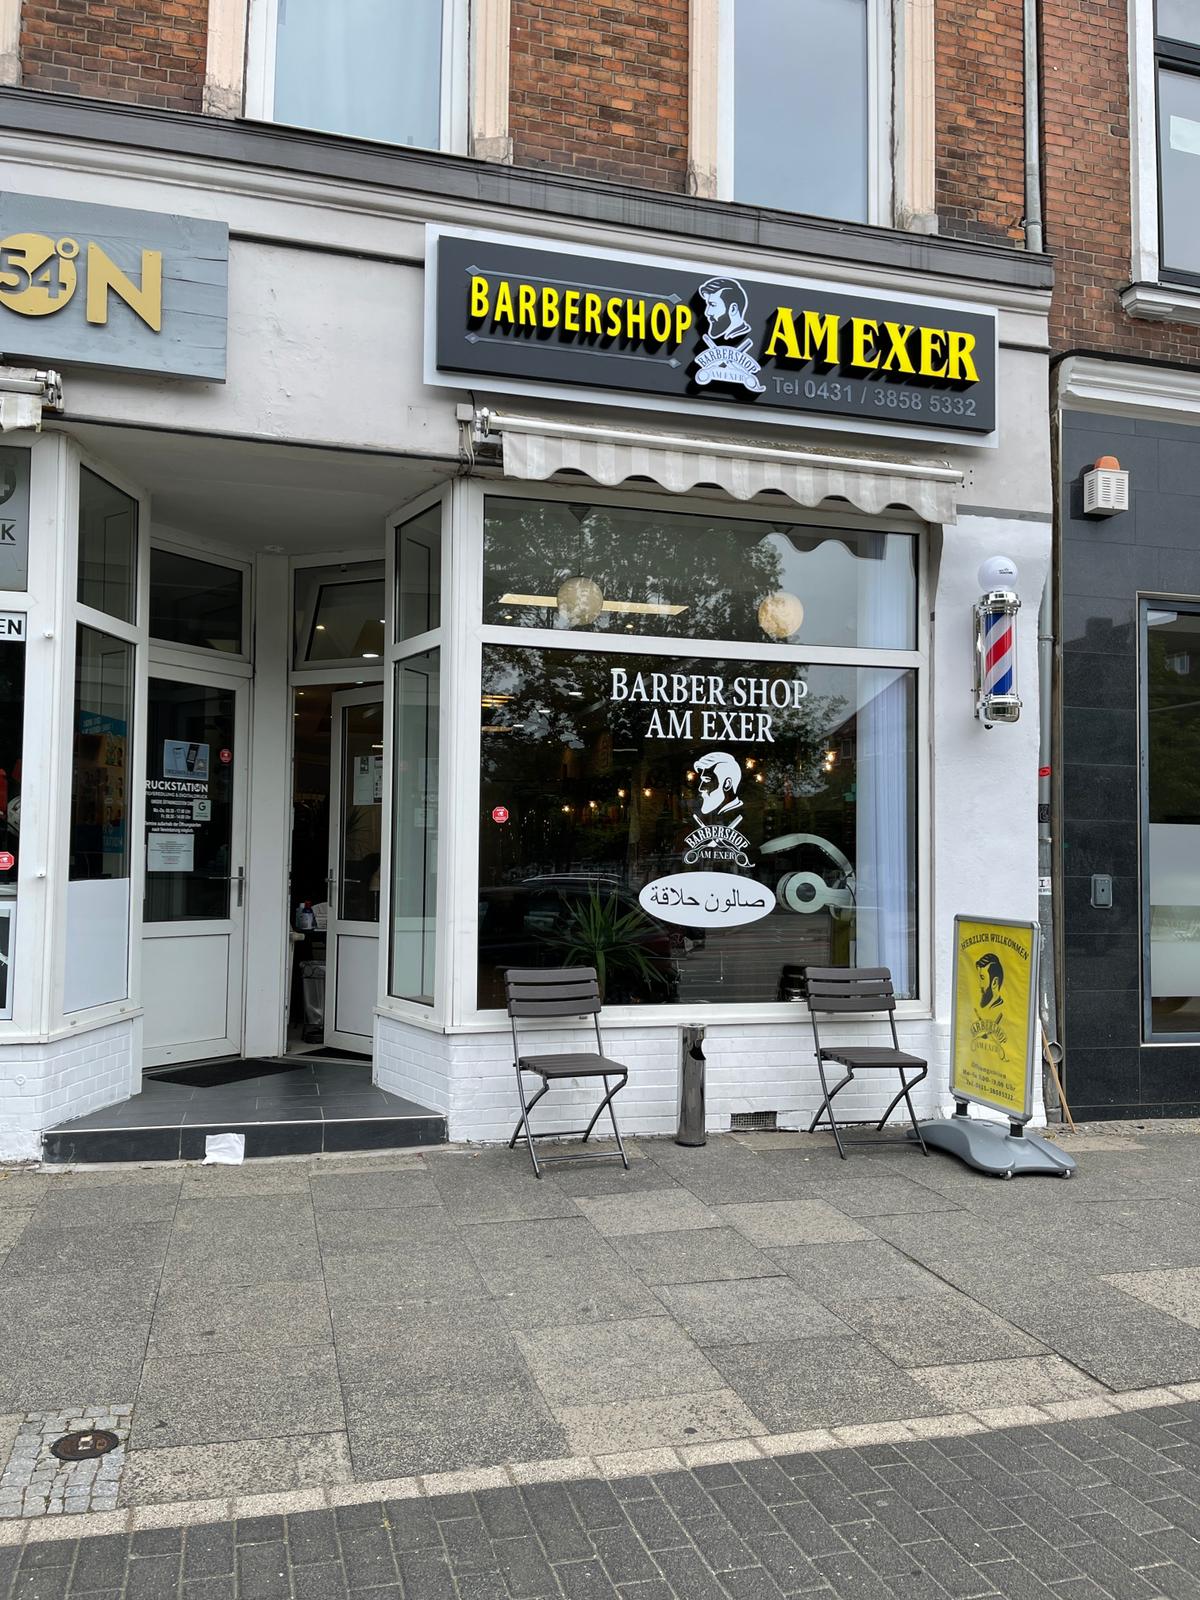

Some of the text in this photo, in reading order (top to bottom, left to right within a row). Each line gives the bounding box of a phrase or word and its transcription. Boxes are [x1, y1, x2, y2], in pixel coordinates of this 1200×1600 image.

[470, 276, 692, 344] BARBERSHOP
[764, 307, 980, 382] AM EXER
[697, 348, 757, 374] BARBERSHOP
[772, 376, 976, 417] Tel 0431 / 3858 5332
[610, 670, 808, 709] BARBER SHOP
[645, 709, 775, 743] AM EXER
[685, 826, 749, 851] BARBERSHOP
[700, 851, 735, 860] AM EXER
[650, 886, 765, 912] صالون حلاقة
[961, 933, 1029, 960] HERZLICH WILLKOMMEN
